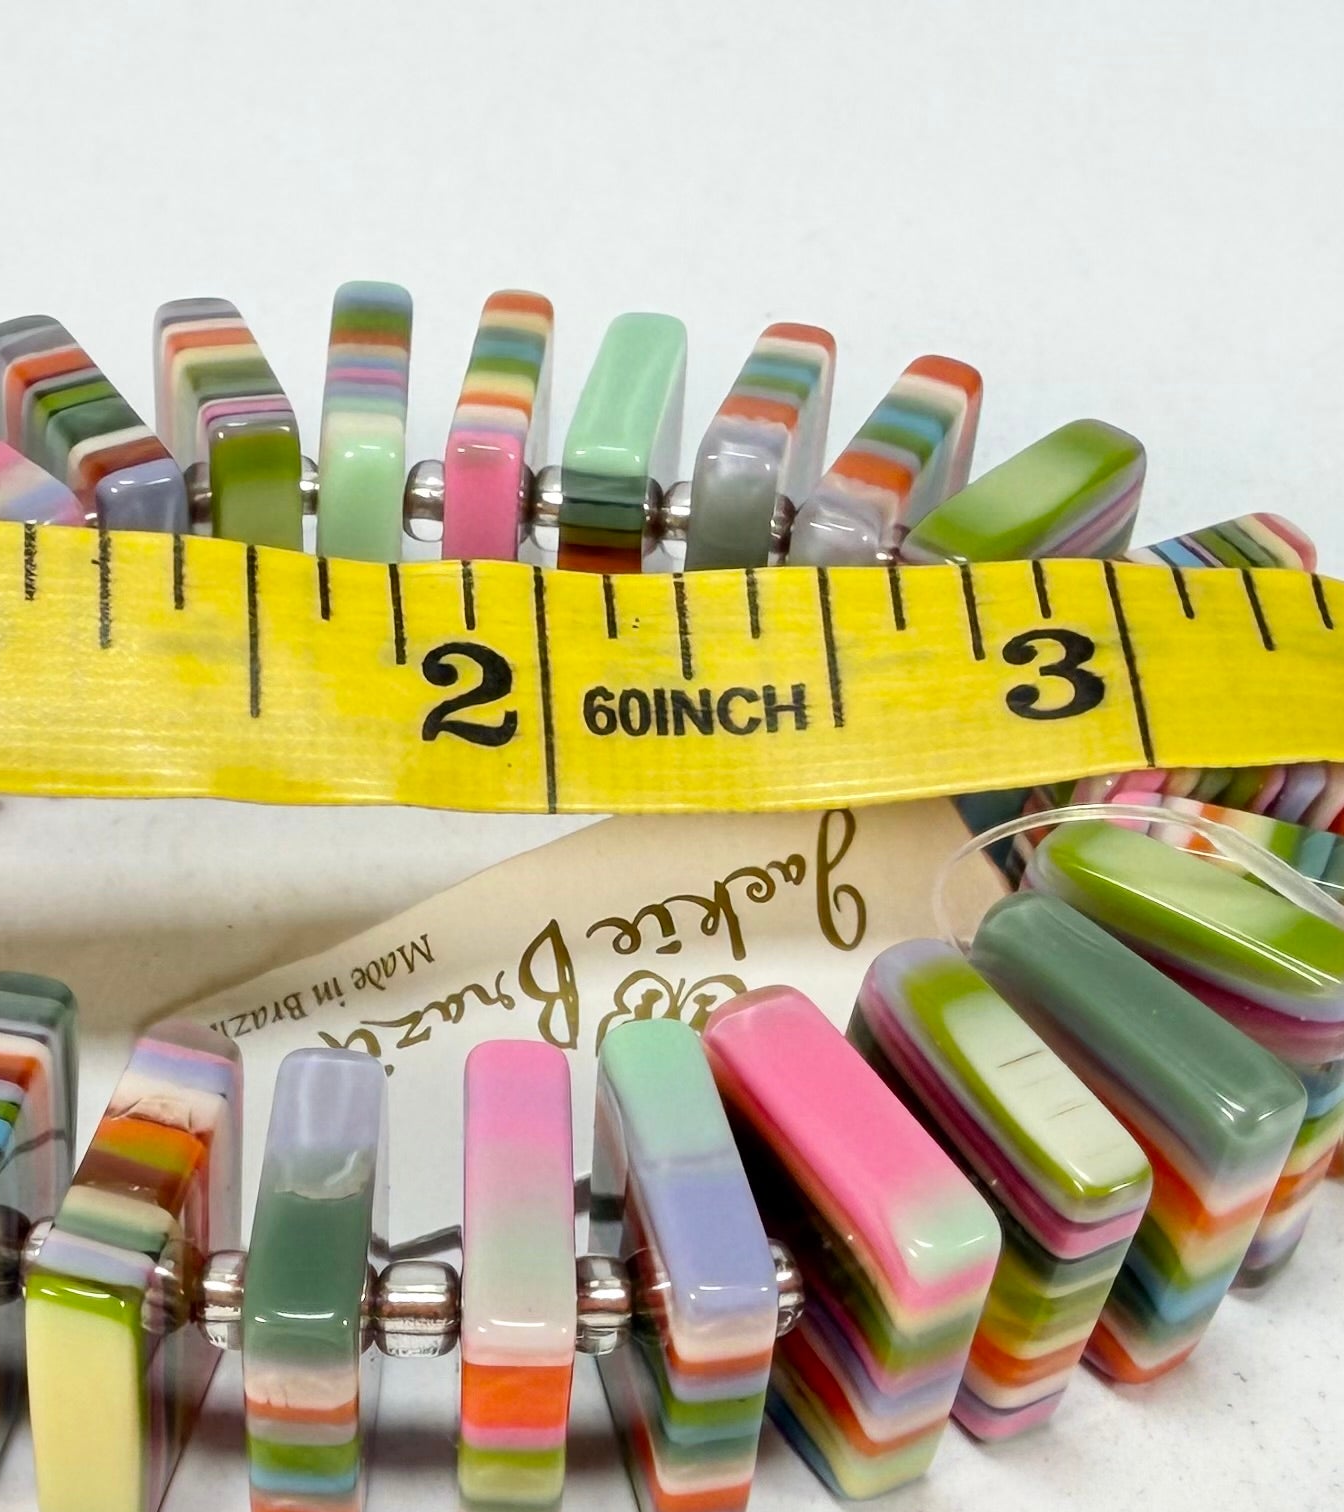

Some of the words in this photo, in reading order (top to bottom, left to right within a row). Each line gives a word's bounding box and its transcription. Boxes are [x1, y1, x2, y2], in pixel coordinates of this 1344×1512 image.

[420, 641, 518, 747] 2
[582, 683, 808, 737] 60INCH
[1001, 628, 1106, 721] 3
[586, 807, 867, 961] Jackie
[311, 976, 347, 1008] in
[350, 933, 436, 992] Made
